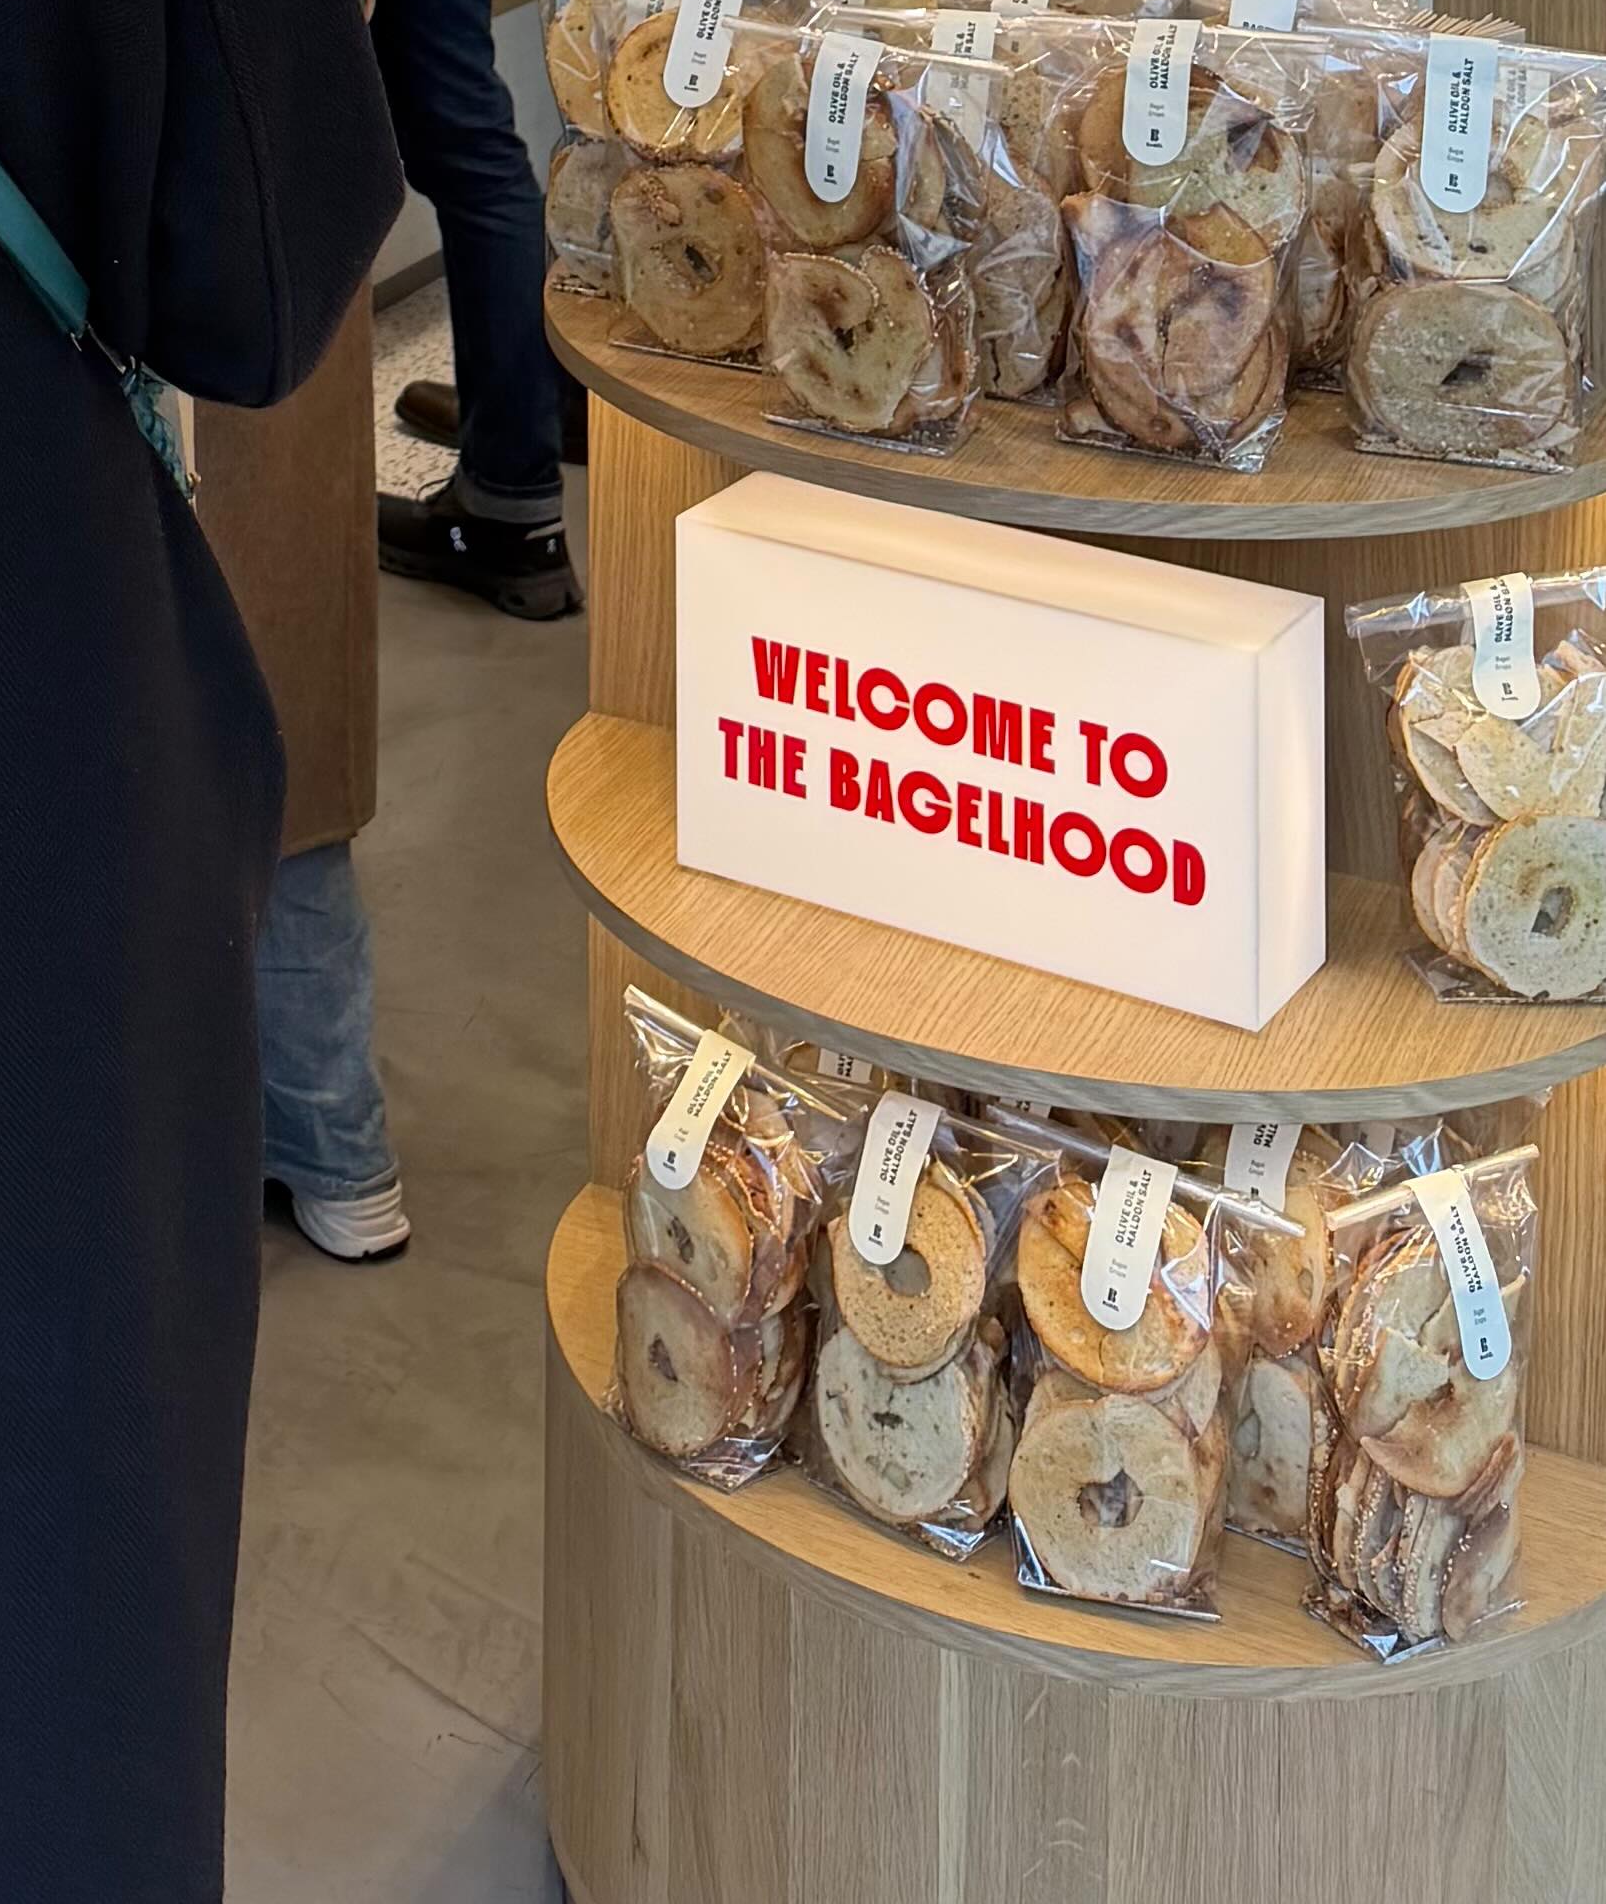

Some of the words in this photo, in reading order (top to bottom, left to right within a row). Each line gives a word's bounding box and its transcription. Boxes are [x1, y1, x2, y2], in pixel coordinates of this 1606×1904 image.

[696, 10, 710, 38] OLIVE
[706, 0, 722, 40] MALDON
[966, 21, 976, 44] SALT
[1150, 57, 1160, 88] OLIVE
[1160, 47, 1172, 89] MALDON
[1166, 24, 1178, 46] SALT
[1464, 58, 1474, 87] SALT
[832, 71, 843, 88] OIL
[837, 76, 852, 125] MALDON
[845, 52, 860, 76] SALT
[1451, 83, 1461, 98] OIL
[1453, 71, 1461, 79] &
[829, 91, 840, 123] OLIVE
[1448, 99, 1460, 132] OLIVE
[1459, 89, 1471, 135] MALDON
[1494, 595, 1502, 611] OIL
[1495, 615, 1504, 642] OLIVE
[1504, 598, 1513, 641] MALDON
[750, 634, 1056, 775] WELCOME
[1079, 719, 1169, 799] TO
[717, 716, 808, 799] THE
[829, 749, 1208, 908] BAGELHOOD
[687, 1085, 704, 1115] OLIVE
[702, 1069, 715, 1083] OIL
[694, 1076, 719, 1118] MALDON
[717, 1050, 732, 1075] SALT
[879, 1148, 893, 1182] OLIVE
[888, 1131, 903, 1145] OIL
[889, 1139, 908, 1185] MALDON
[906, 1109, 918, 1138] SALT
[1124, 1191, 1135, 1207] OIL
[1129, 1180, 1138, 1188] &
[1126, 1200, 1145, 1248] MALDON
[1140, 1169, 1152, 1199] SALT
[1450, 1205, 1465, 1235] SALT
[1115, 1210, 1129, 1242] OLIVE
[1454, 1236, 1464, 1254] OIL
[1461, 1257, 1475, 1293] OLIVE
[1462, 1237, 1483, 1290] MALDON
